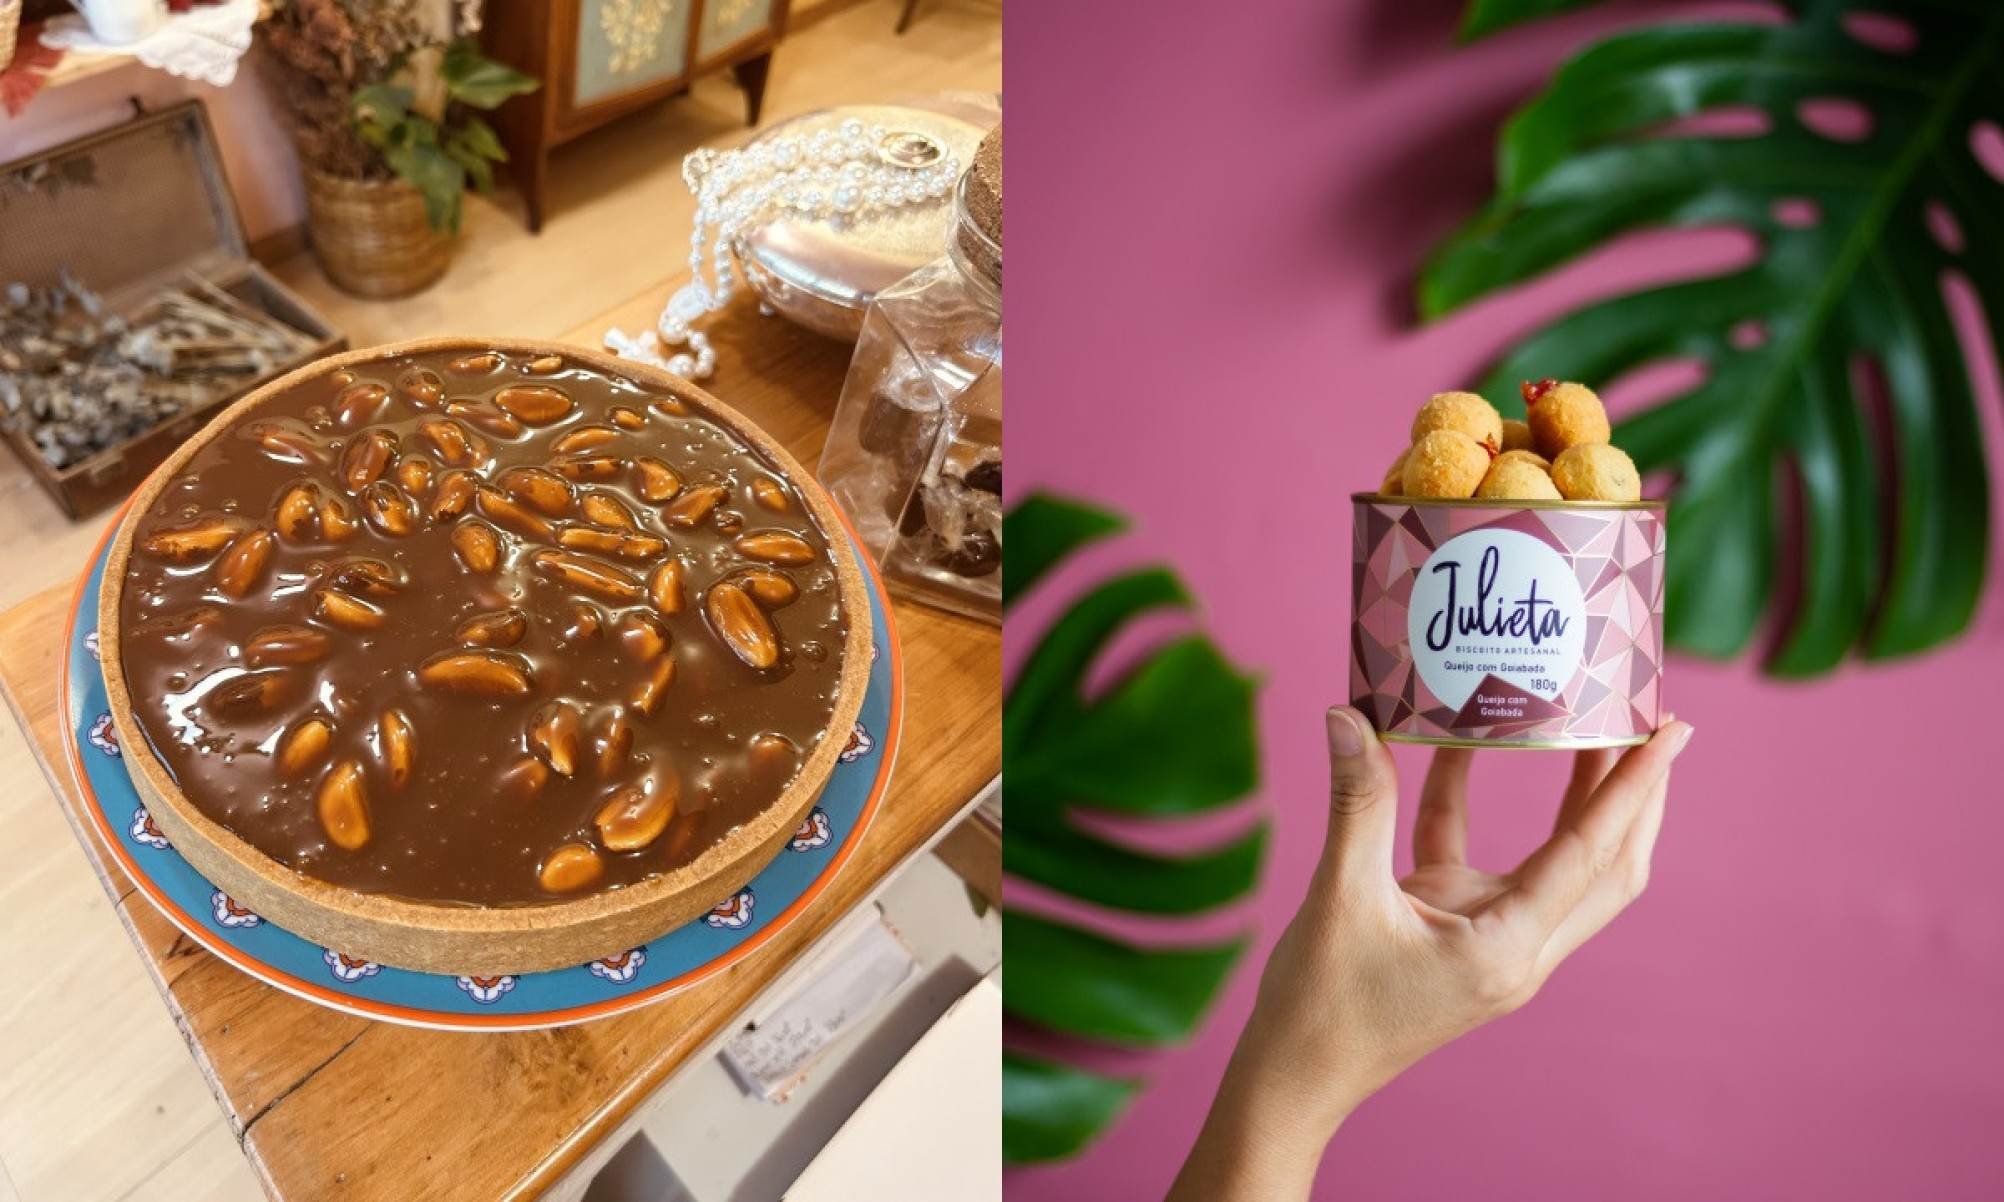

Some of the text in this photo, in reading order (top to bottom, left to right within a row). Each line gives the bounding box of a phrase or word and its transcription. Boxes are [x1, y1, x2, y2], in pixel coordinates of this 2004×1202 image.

[1426, 546, 1571, 651] Julieta
[1456, 645, 1561, 656] BISCOITO ARTESANAL
[1444, 661, 1545, 674] Queijo com Goiabada
[1530, 679, 1557, 691] 180g
[1477, 695, 1506, 705] Queijo
[1481, 707, 1523, 717] Goiabada
